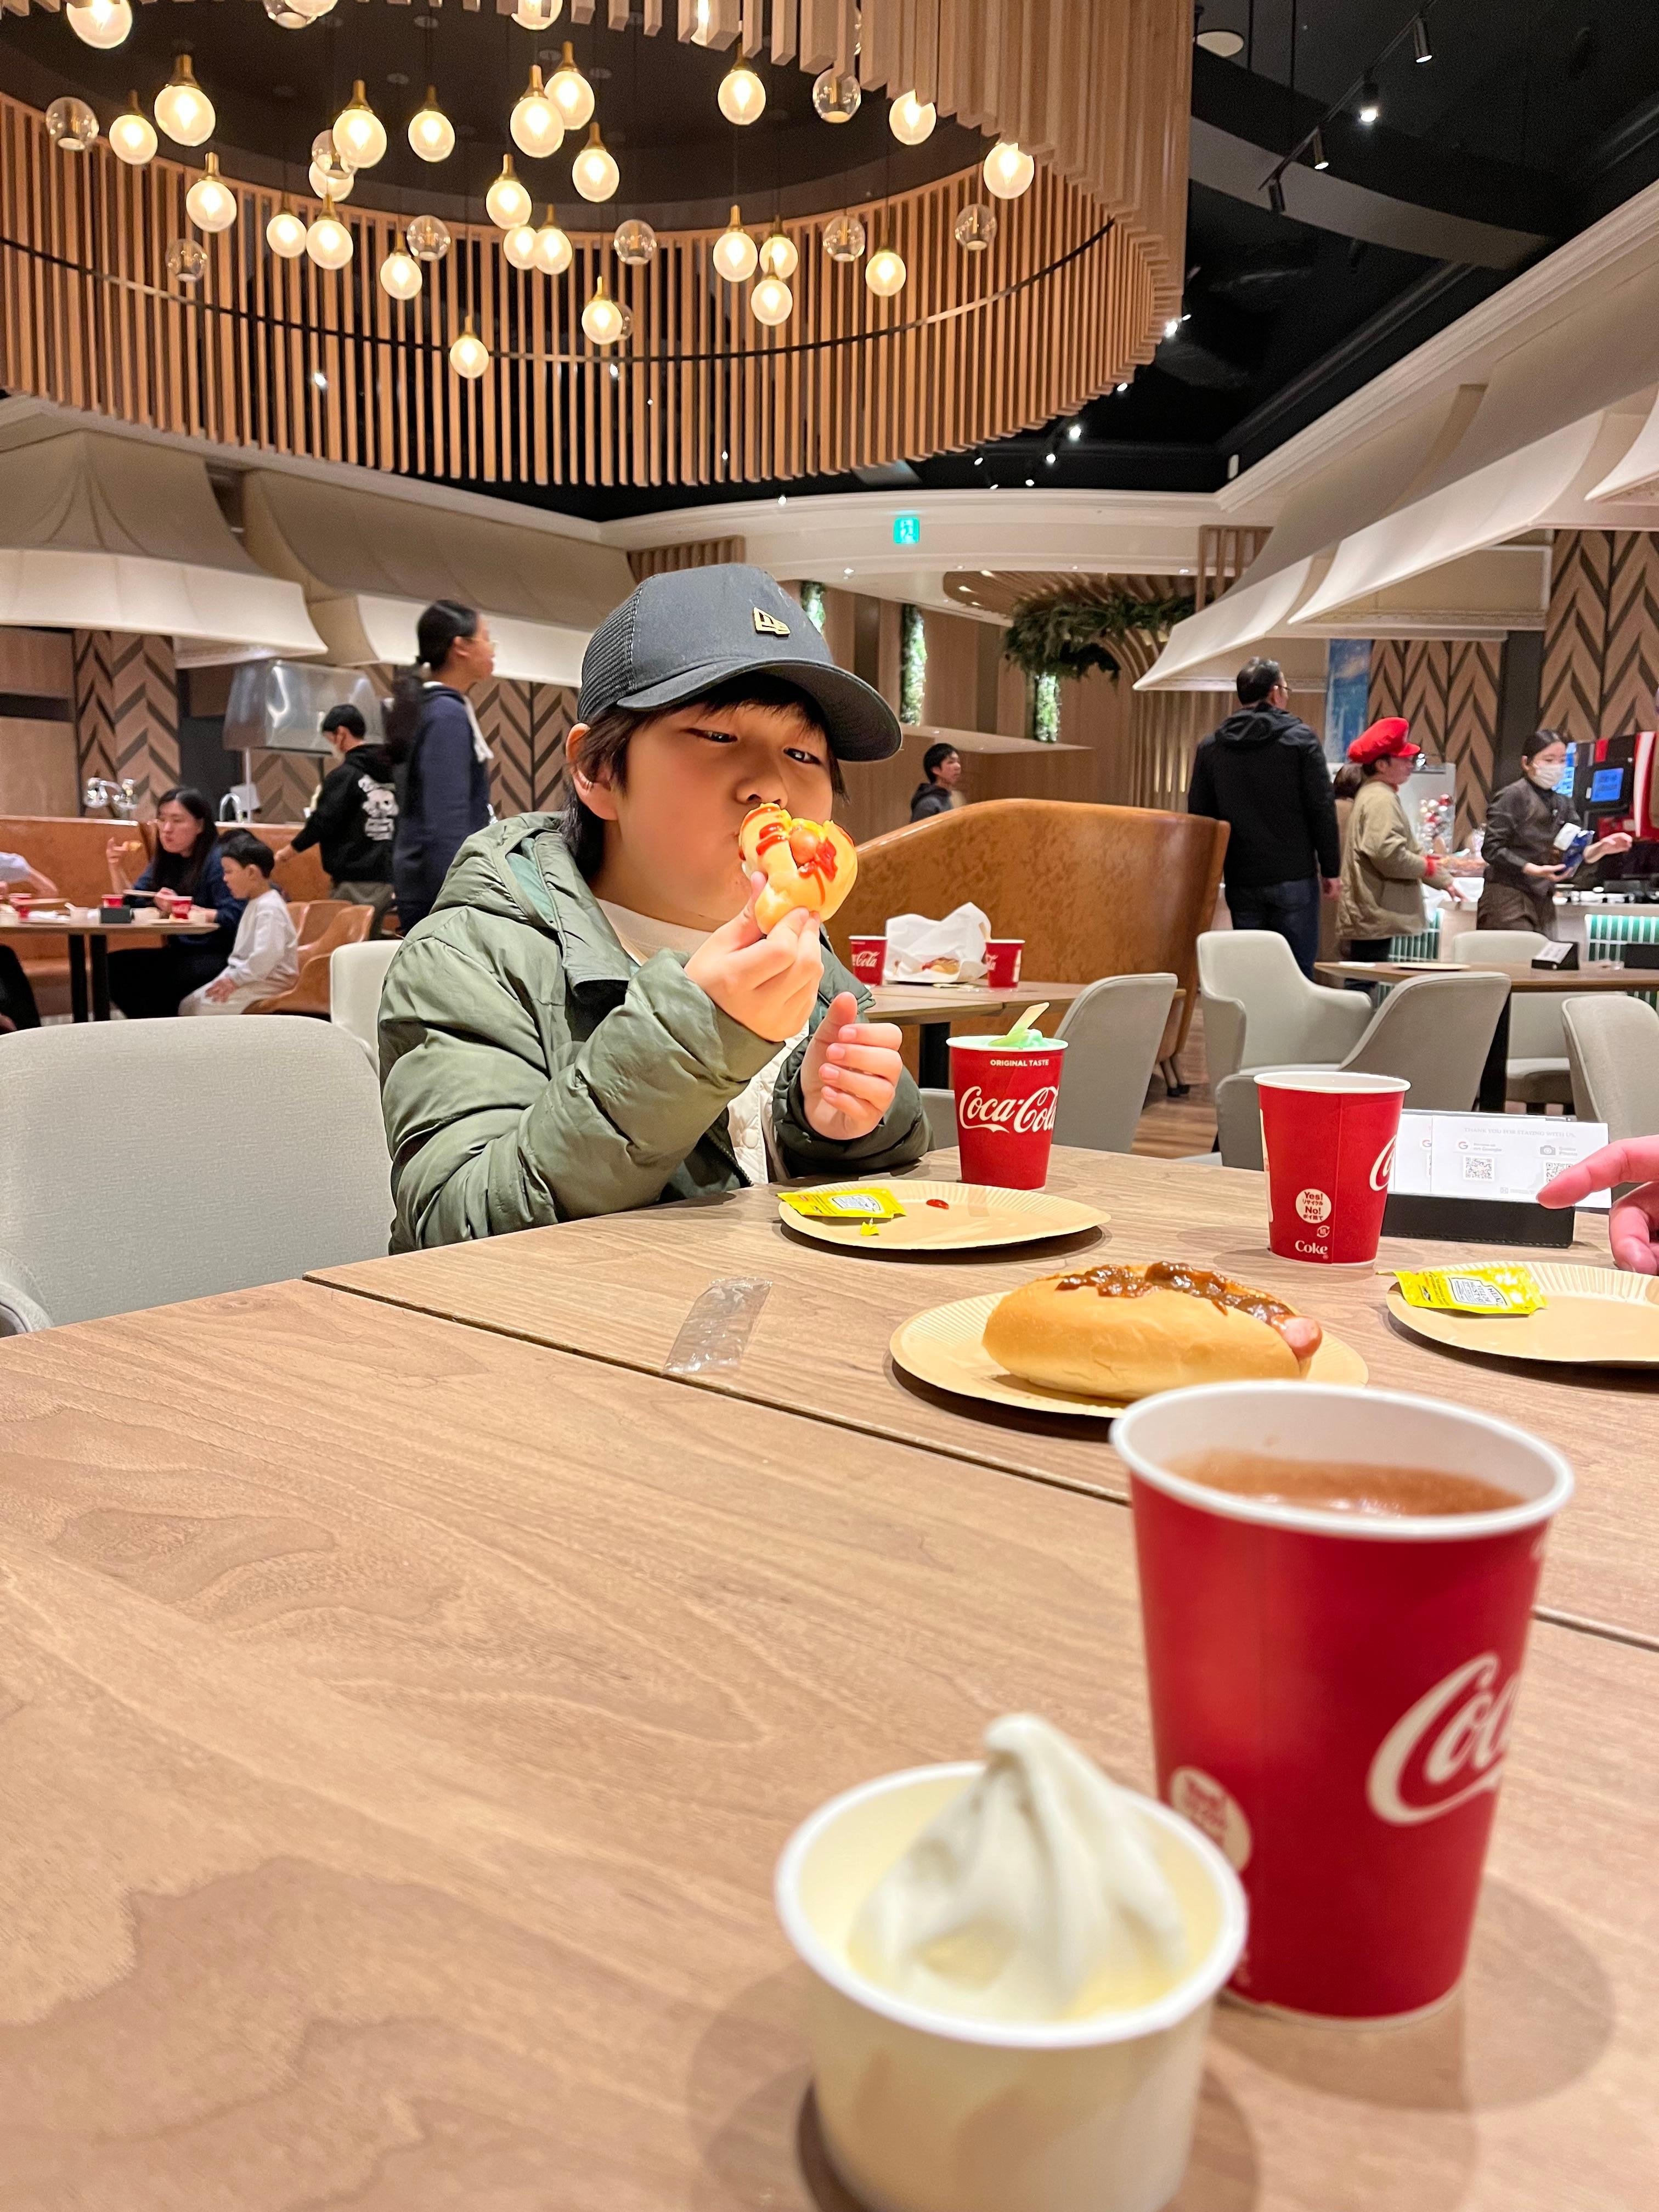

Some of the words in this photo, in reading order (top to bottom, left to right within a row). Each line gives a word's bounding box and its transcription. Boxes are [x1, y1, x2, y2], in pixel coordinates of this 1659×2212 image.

[1304, 1191, 1323, 1200] Yes!
[1305, 1206, 1321, 1215] No!
[1295, 1240, 1328, 1255] Coke
